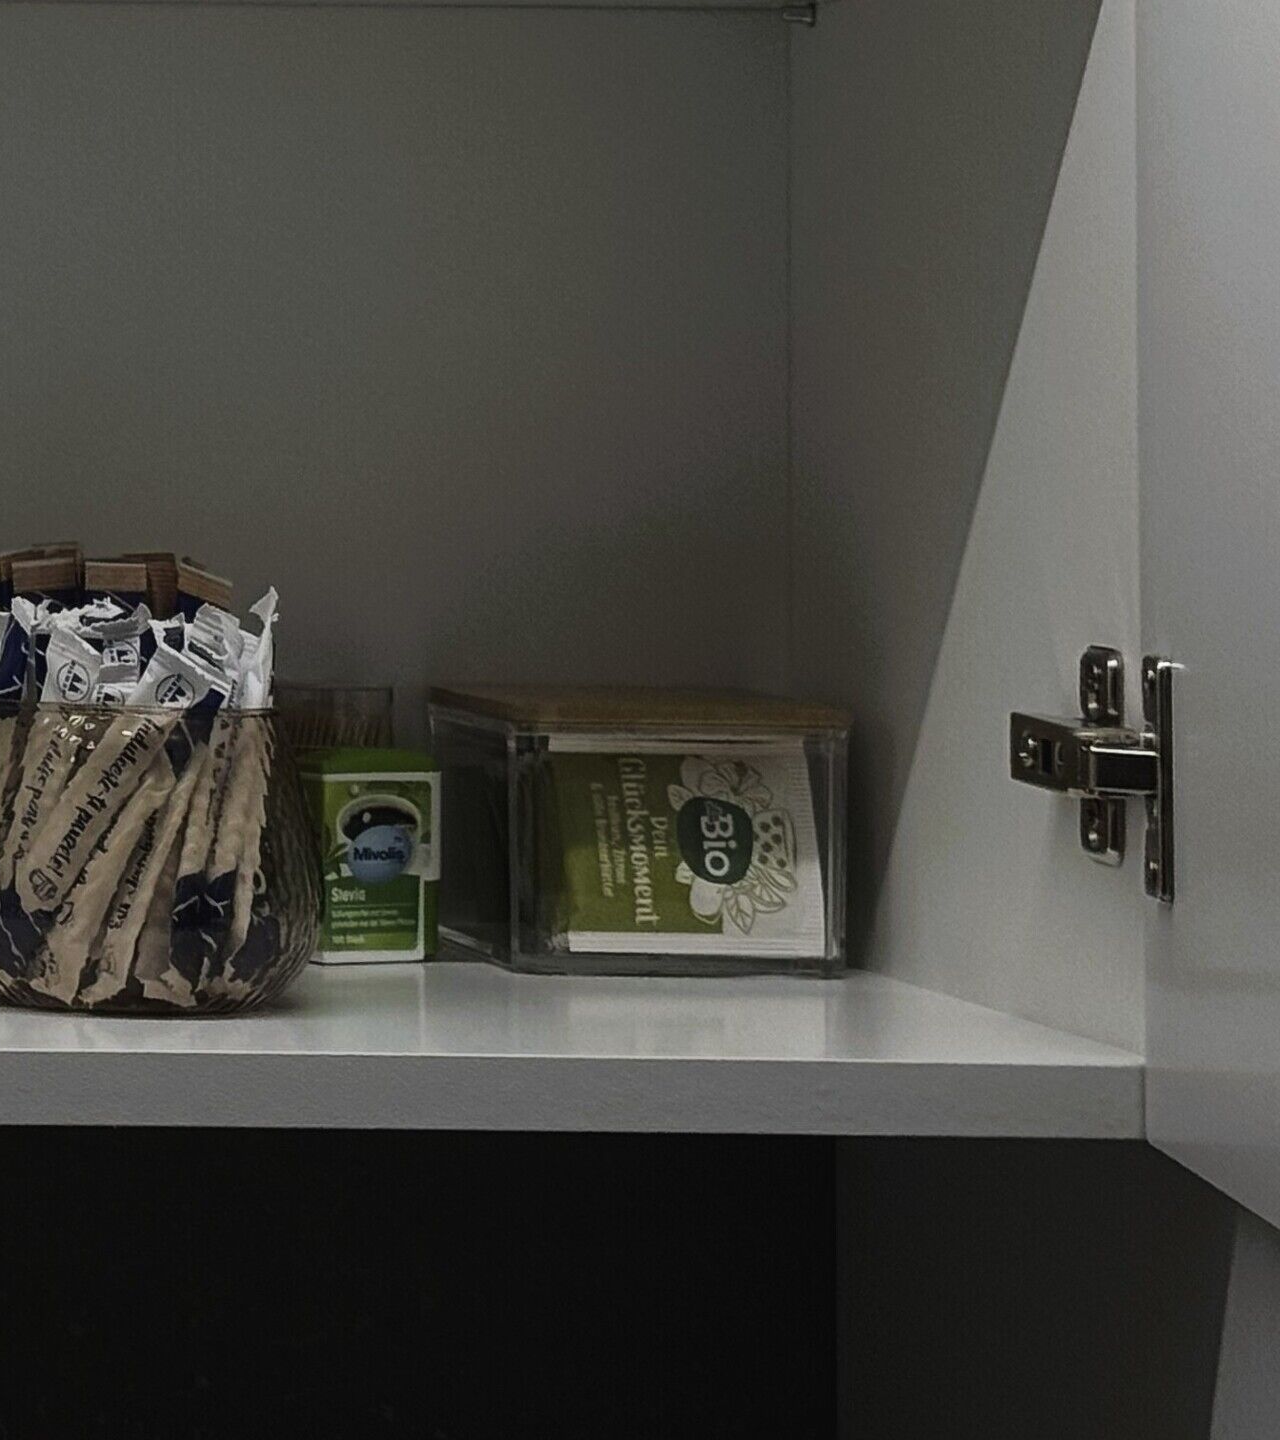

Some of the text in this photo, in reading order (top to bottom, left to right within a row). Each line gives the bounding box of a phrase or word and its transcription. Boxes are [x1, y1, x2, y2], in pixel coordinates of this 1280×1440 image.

[650, 816, 668, 858] Dein
[700, 813, 737, 877] Bio
[353, 846, 406, 861] Mivolis
[331, 887, 366, 902] Stevia
